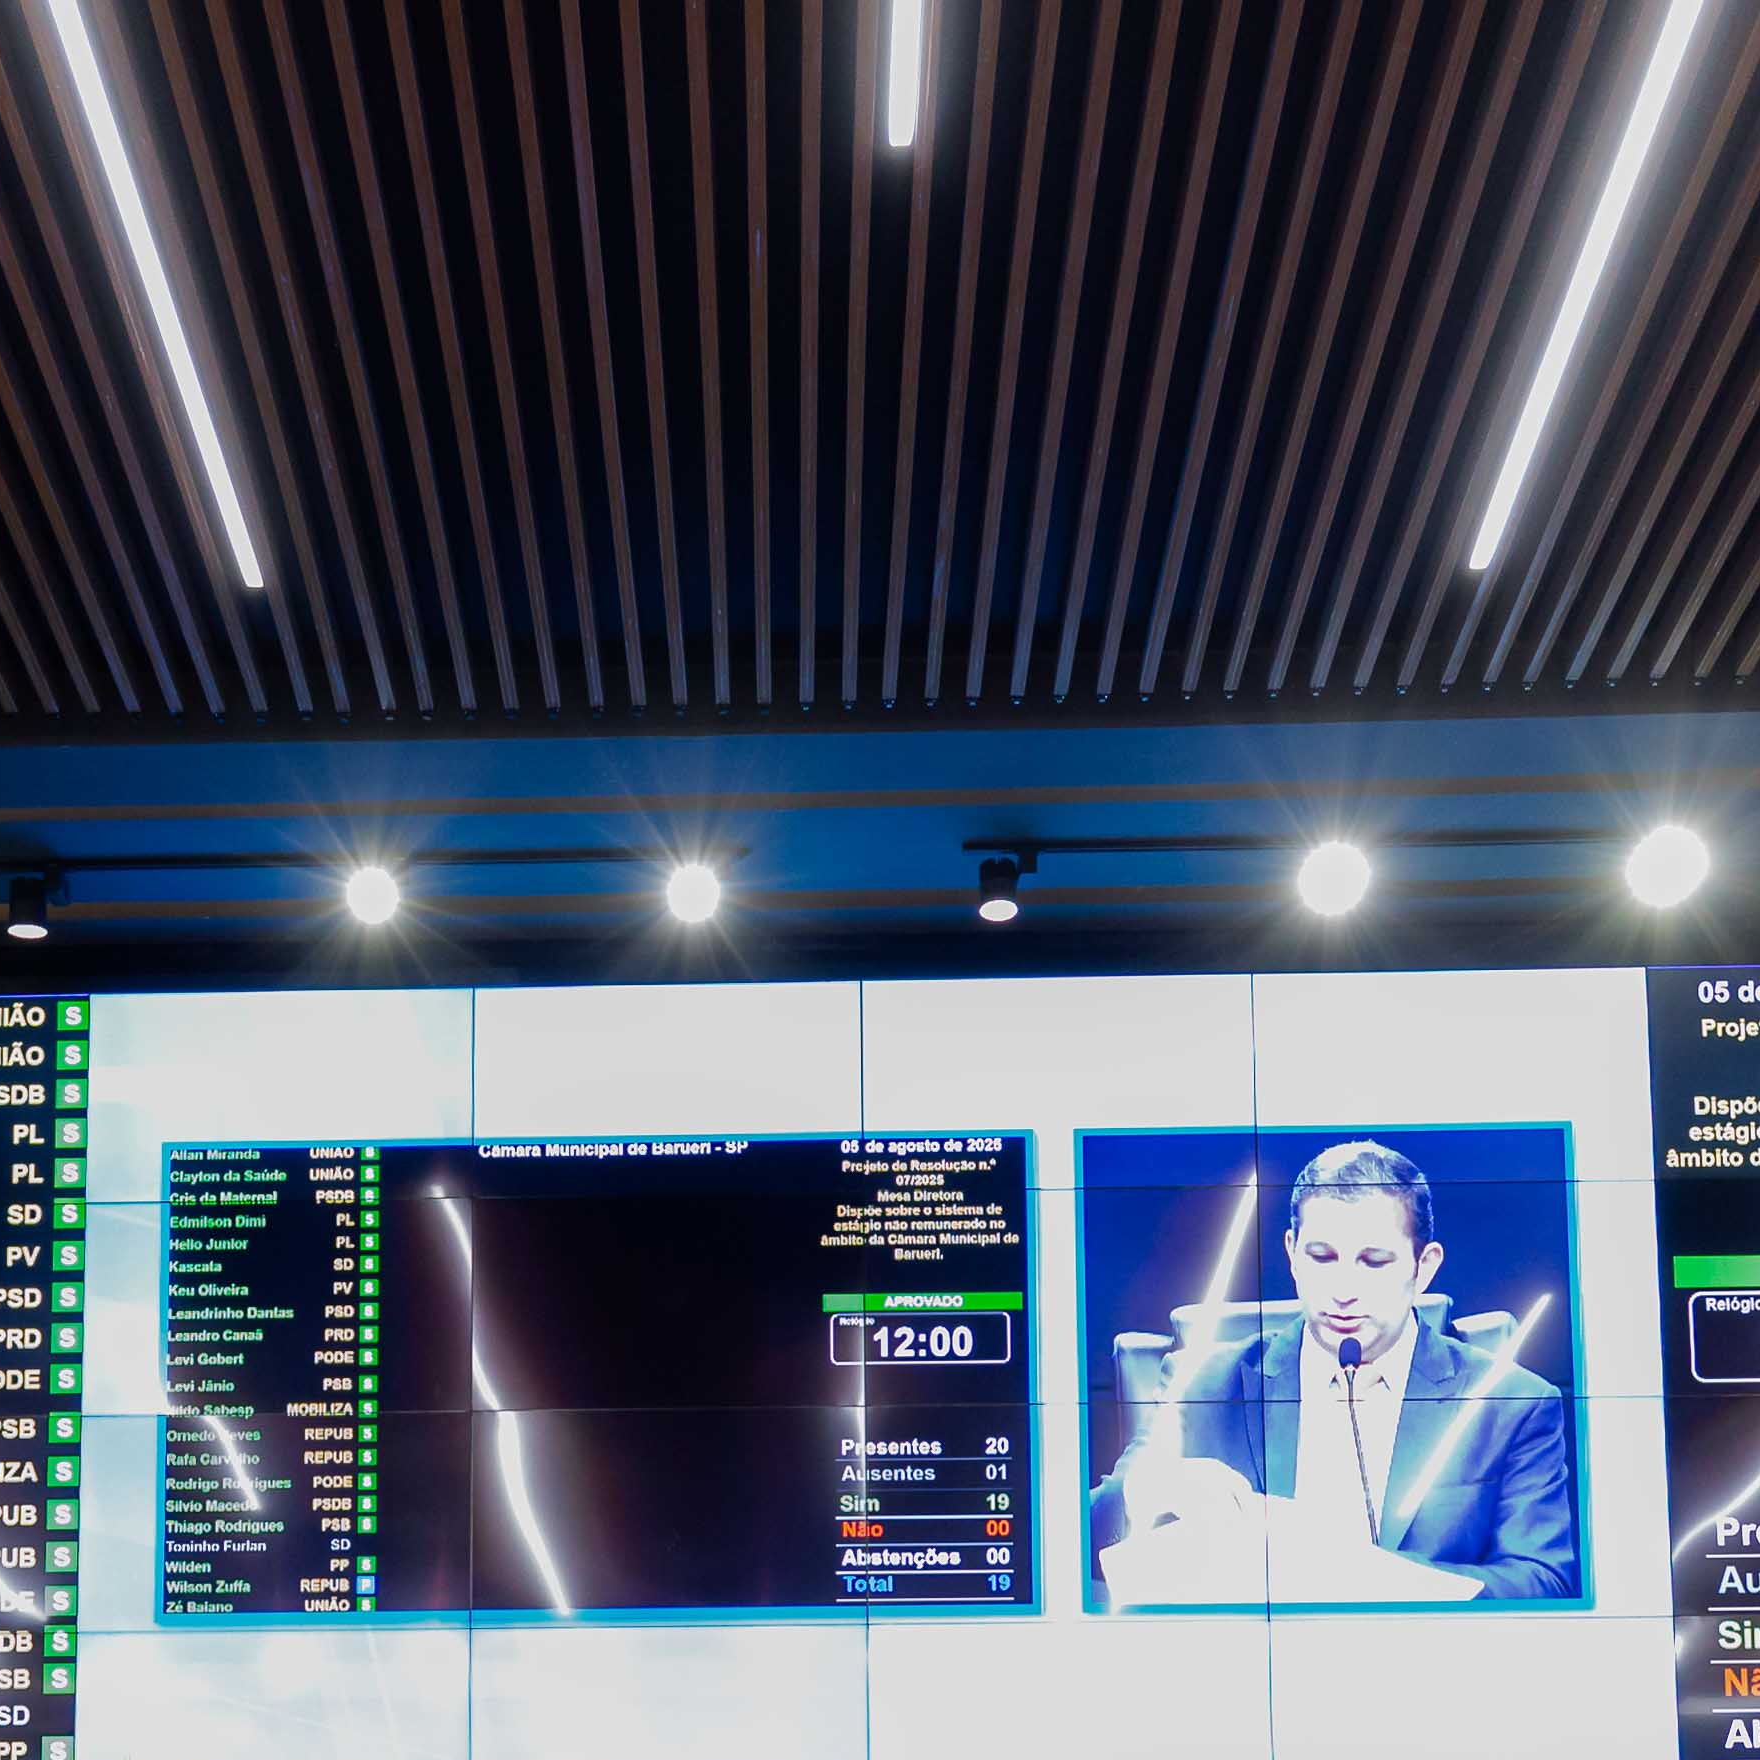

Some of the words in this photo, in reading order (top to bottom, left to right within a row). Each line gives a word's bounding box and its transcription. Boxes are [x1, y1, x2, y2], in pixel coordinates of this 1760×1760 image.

[1698, 982, 1729, 1003] 05
[66, 1007, 81, 1025] S
[65, 1046, 81, 1064] S
[64, 1085, 80, 1103] S
[13, 1125, 44, 1145] PL
[63, 1125, 79, 1142] S
[1667, 1149, 1743, 1168] âmbito
[12, 1165, 43, 1184] PL
[62, 1164, 78, 1182] S
[8, 1206, 42, 1225] SD
[61, 1206, 77, 1223] S
[6, 1247, 40, 1267] PV
[61, 1247, 77, 1265] S
[60, 1288, 76, 1306] S
[59, 1328, 75, 1347] S
[873, 1326, 974, 1357] 12:00
[58, 1369, 74, 1388] S
[56, 1418, 73, 1437] S
[841, 1438, 942, 1455] Presentes
[985, 1437, 1009, 1454] 20
[56, 1462, 72, 1482] S
[841, 1465, 935, 1481] Ausentes
[986, 1464, 1007, 1480] 01
[840, 1496, 880, 1512] Sim
[986, 1494, 1010, 1511] 19
[54, 1505, 71, 1526] S
[842, 1521, 883, 1537] Não
[986, 1520, 1010, 1536] 00
[166, 1540, 220, 1552] Toninho
[54, 1548, 70, 1567] S
[841, 1548, 961, 1569] Abstenções
[986, 1548, 1010, 1564] 00
[843, 1576, 893, 1592] Total
[988, 1575, 1011, 1591] 19
[53, 1593, 69, 1612] S
[52, 1632, 69, 1651] S
[51, 1670, 68, 1688] S
